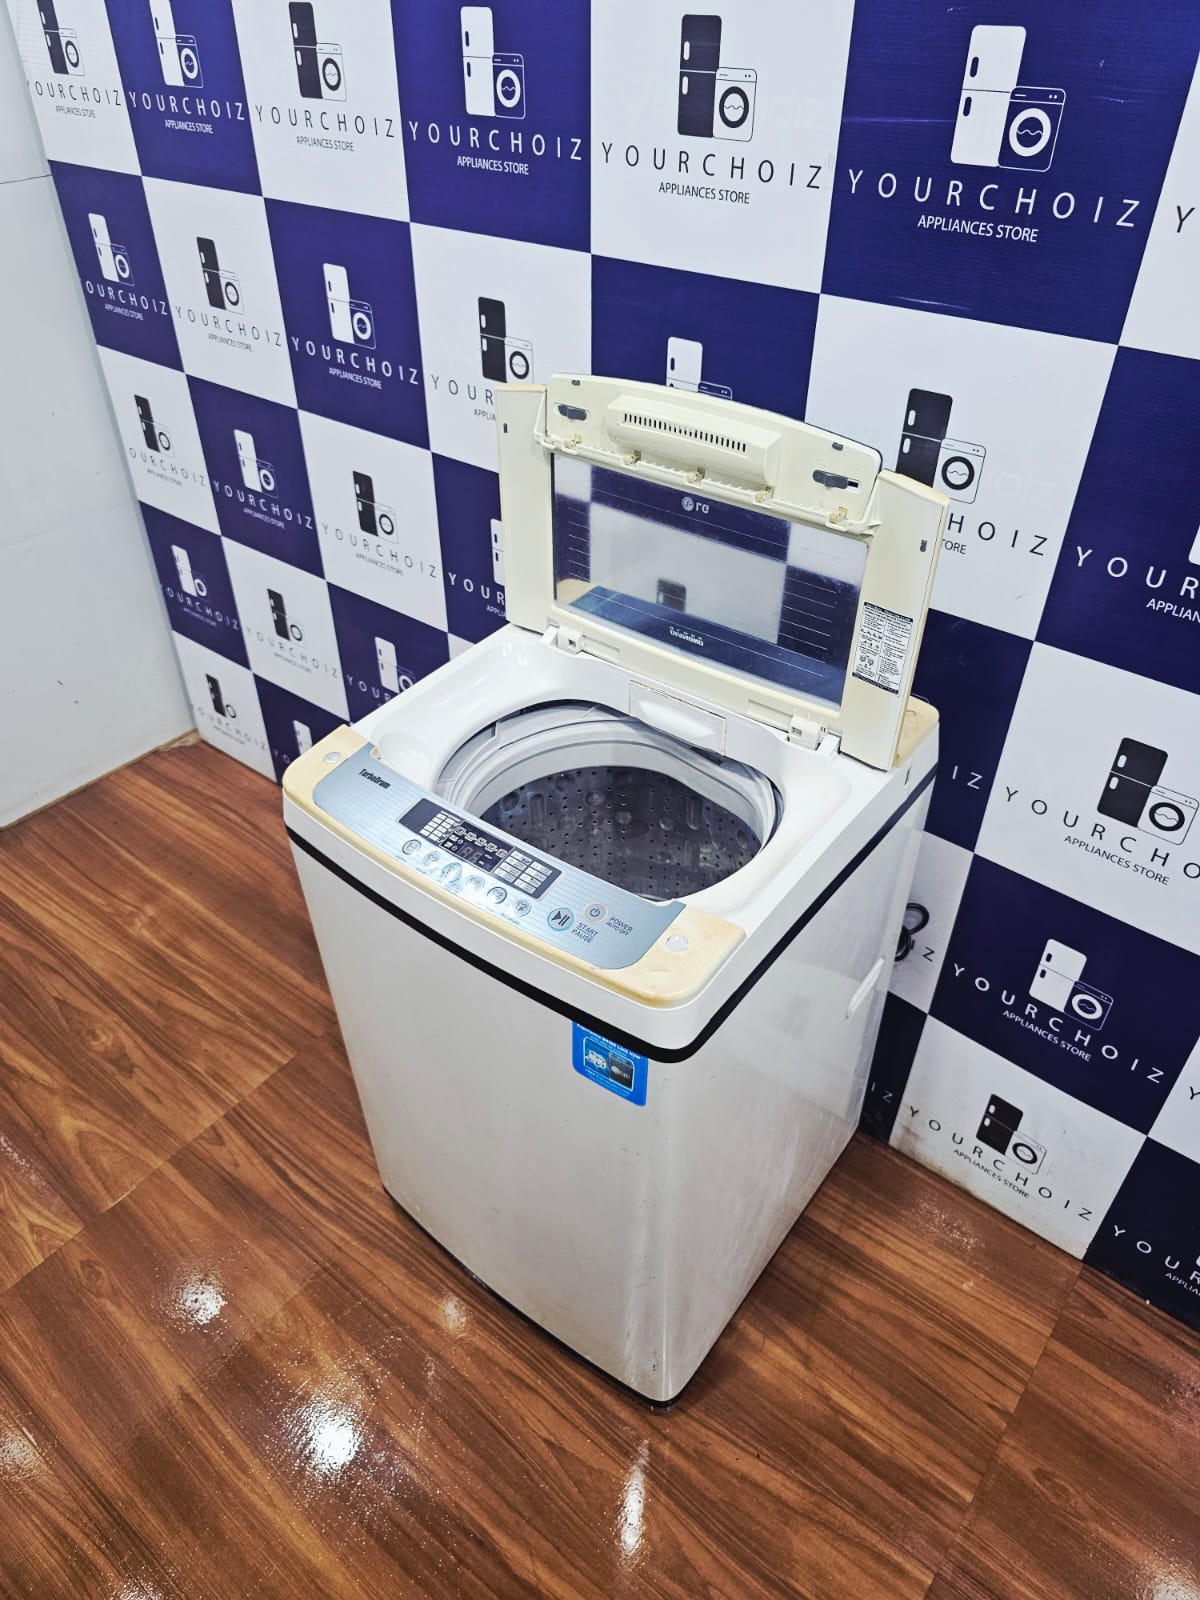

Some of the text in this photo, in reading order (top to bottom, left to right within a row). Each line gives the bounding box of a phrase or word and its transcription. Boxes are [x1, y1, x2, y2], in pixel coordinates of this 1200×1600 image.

[129, 91, 245, 121] YOURCHOIZ
[255, 104, 395, 138] YOURCHOIZ
[296, 136, 354, 152] APPLIANCES STORE
[408, 121, 583, 161] YOURCHOIZ
[457, 156, 529, 175] APPLIANCES STORE
[601, 141, 822, 190] YOURCHOIZ
[658, 181, 750, 205] APPLIANCES STORE
[848, 169, 1140, 228] YOURCHOIZ
[917, 215, 1039, 243] APPLIANCES STORE
[84, 280, 168, 315] OURCHOIZ
[176, 305, 282, 347] YOURCHOIZ
[291, 336, 419, 385] YOURCHOIZ
[328, 369, 382, 390] APPLIANCES STORE
[129, 447, 206, 487] OURCHOIZ
[213, 480, 313, 530] YOURCHOIZ
[320, 522, 437, 579] YOURCHOIZ
[166, 586, 240, 630] OURCHOIZ
[1146, 598, 1200, 623] APPLIAN
[1005, 786, 1200, 879] YOURCHO
[1064, 835, 1170, 886] APPLIANCES STORE
[571, 929, 593, 943] PAUSE
[577, 922, 599, 936] START
[609, 917, 633, 932] POWER
[954, 963, 1164, 1084] YOURCHOIZ
[1002, 1010, 1091, 1062] APPLIANCES STORE
[909, 1106, 1093, 1221] YOURCHOIZ
[953, 1149, 1030, 1199] APPLIANCES STORE
